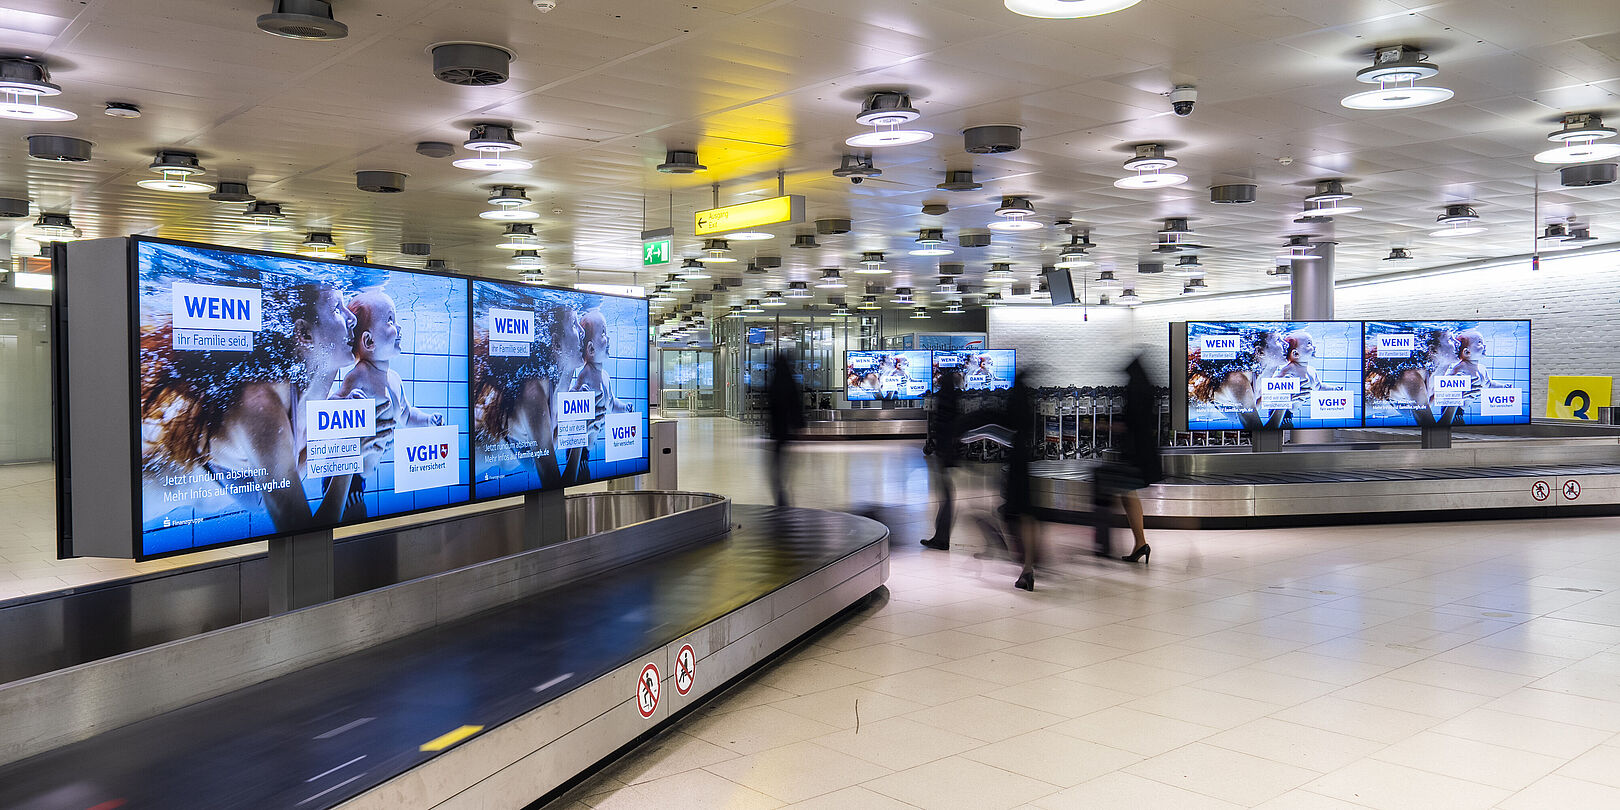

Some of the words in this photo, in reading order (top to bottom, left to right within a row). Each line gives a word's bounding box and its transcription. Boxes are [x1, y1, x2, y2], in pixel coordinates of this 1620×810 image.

[709, 221, 718, 229] Exit
[184, 295, 250, 320] WENN
[494, 317, 529, 335] WENN
[177, 333, 190, 345] ihr
[193, 333, 226, 346] Familie
[228, 335, 249, 347] seid,
[1205, 339, 1235, 348] WENN
[1381, 338, 1410, 347] WENN
[499, 344, 517, 354] Familie
[1267, 381, 1294, 391] DANN
[1440, 379, 1465, 388] DANN
[1318, 398, 1339, 407] VGH
[1488, 395, 1508, 404] VGH
[563, 399, 590, 415] DANN
[318, 409, 366, 431] DANN
[559, 424, 568, 432] sind
[612, 426, 630, 440] VGH
[310, 444, 327, 455] sind
[327, 444, 340, 454] wir
[341, 443, 358, 453] eure
[406, 444, 438, 463] VGH
[310, 461, 360, 474] Versicherung.
[409, 464, 419, 473] fair
[419, 462, 447, 472] versichert
[163, 475, 187, 487] Jetzt
[188, 471, 224, 483] rundum
[226, 467, 269, 480] absichern.
[163, 491, 188, 503] Mehr
[190, 488, 213, 500] Infos
[214, 485, 229, 497] auf
[229, 477, 291, 495] familie.vgh.de
[172, 517, 205, 527] Finanzgruppe
